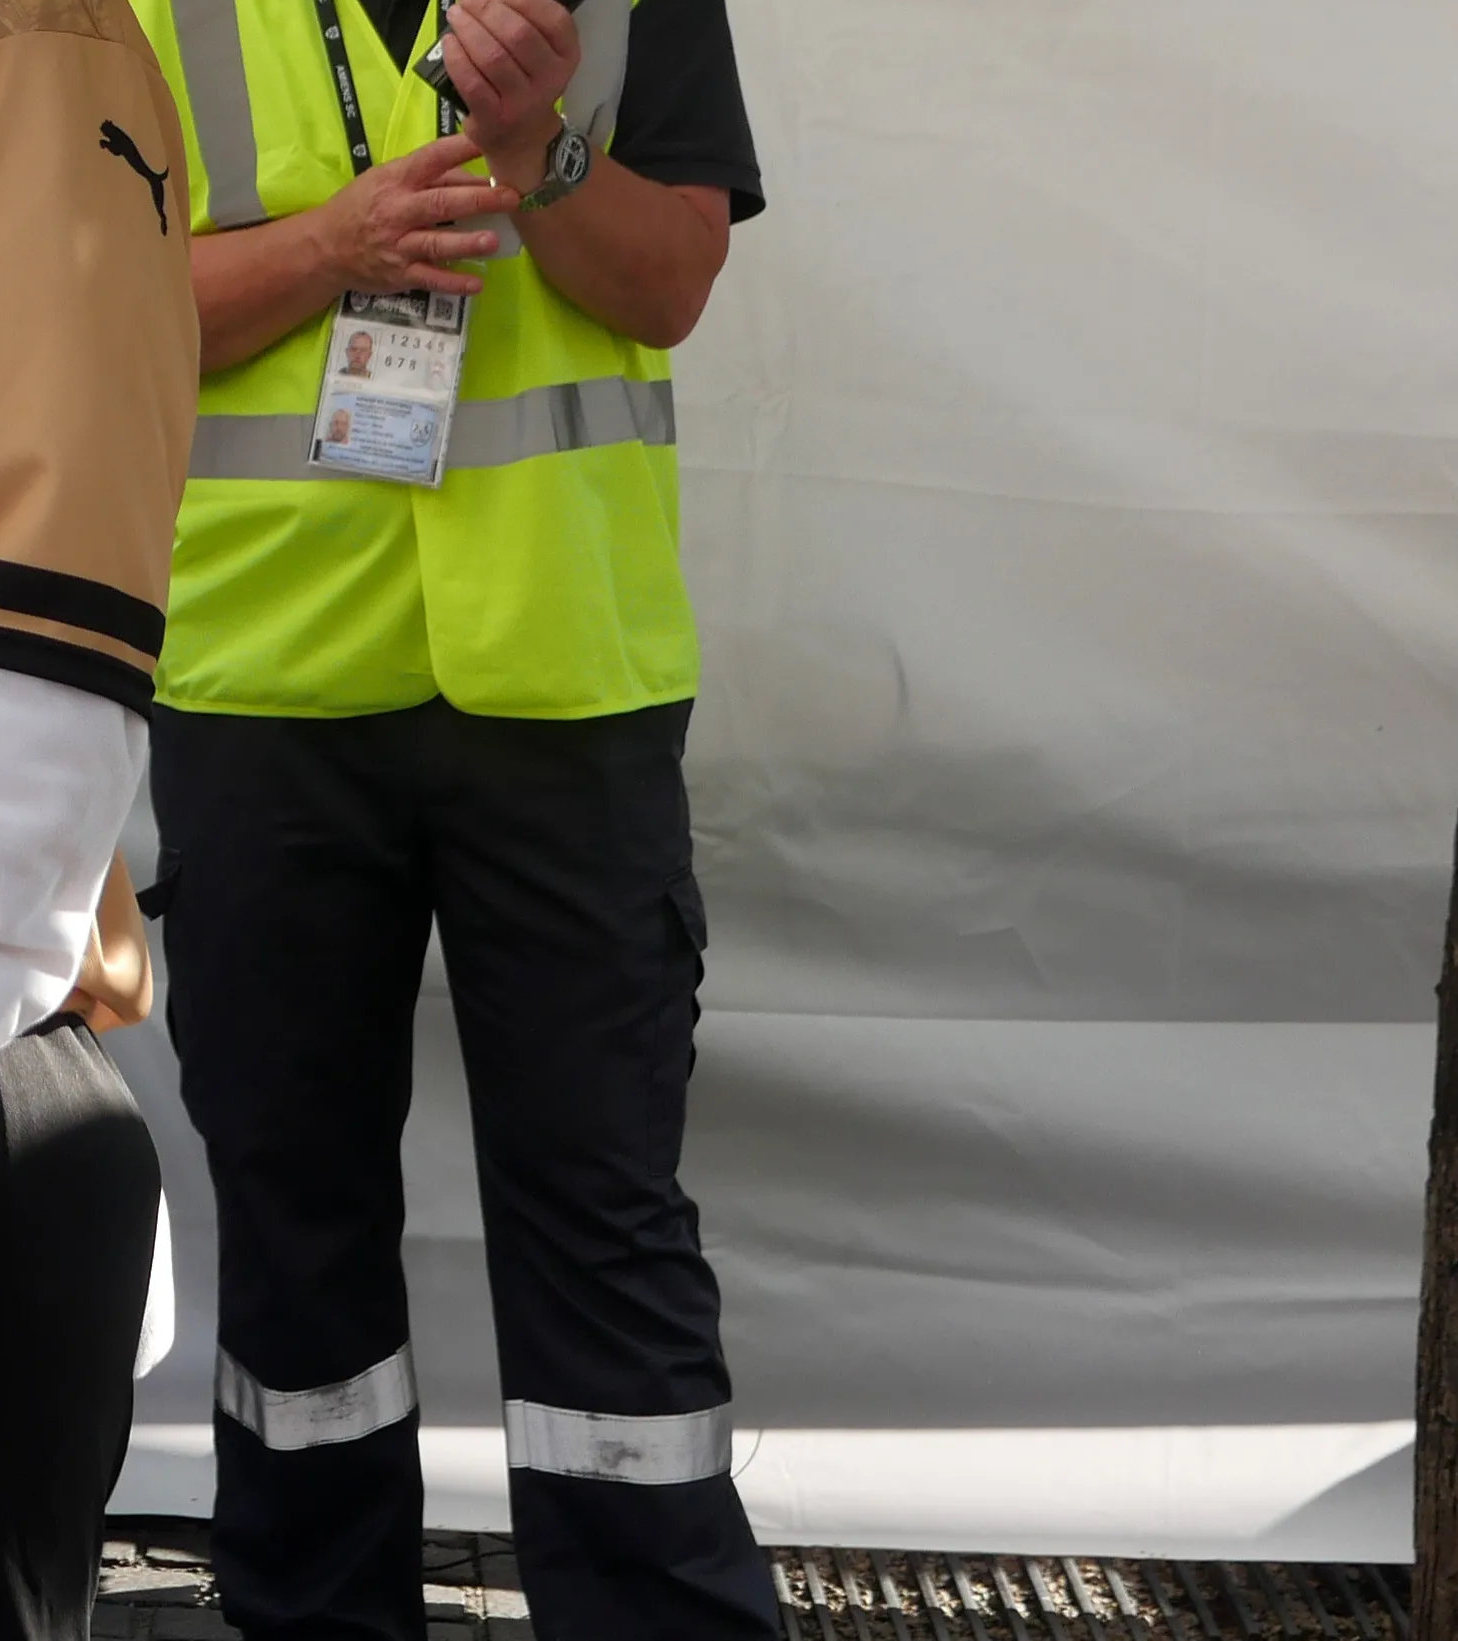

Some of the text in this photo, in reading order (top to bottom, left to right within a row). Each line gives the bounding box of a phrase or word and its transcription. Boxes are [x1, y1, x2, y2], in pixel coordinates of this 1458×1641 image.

[335, 65, 357, 119] AMIENS SC
[440, 97, 450, 133] AMIEN
